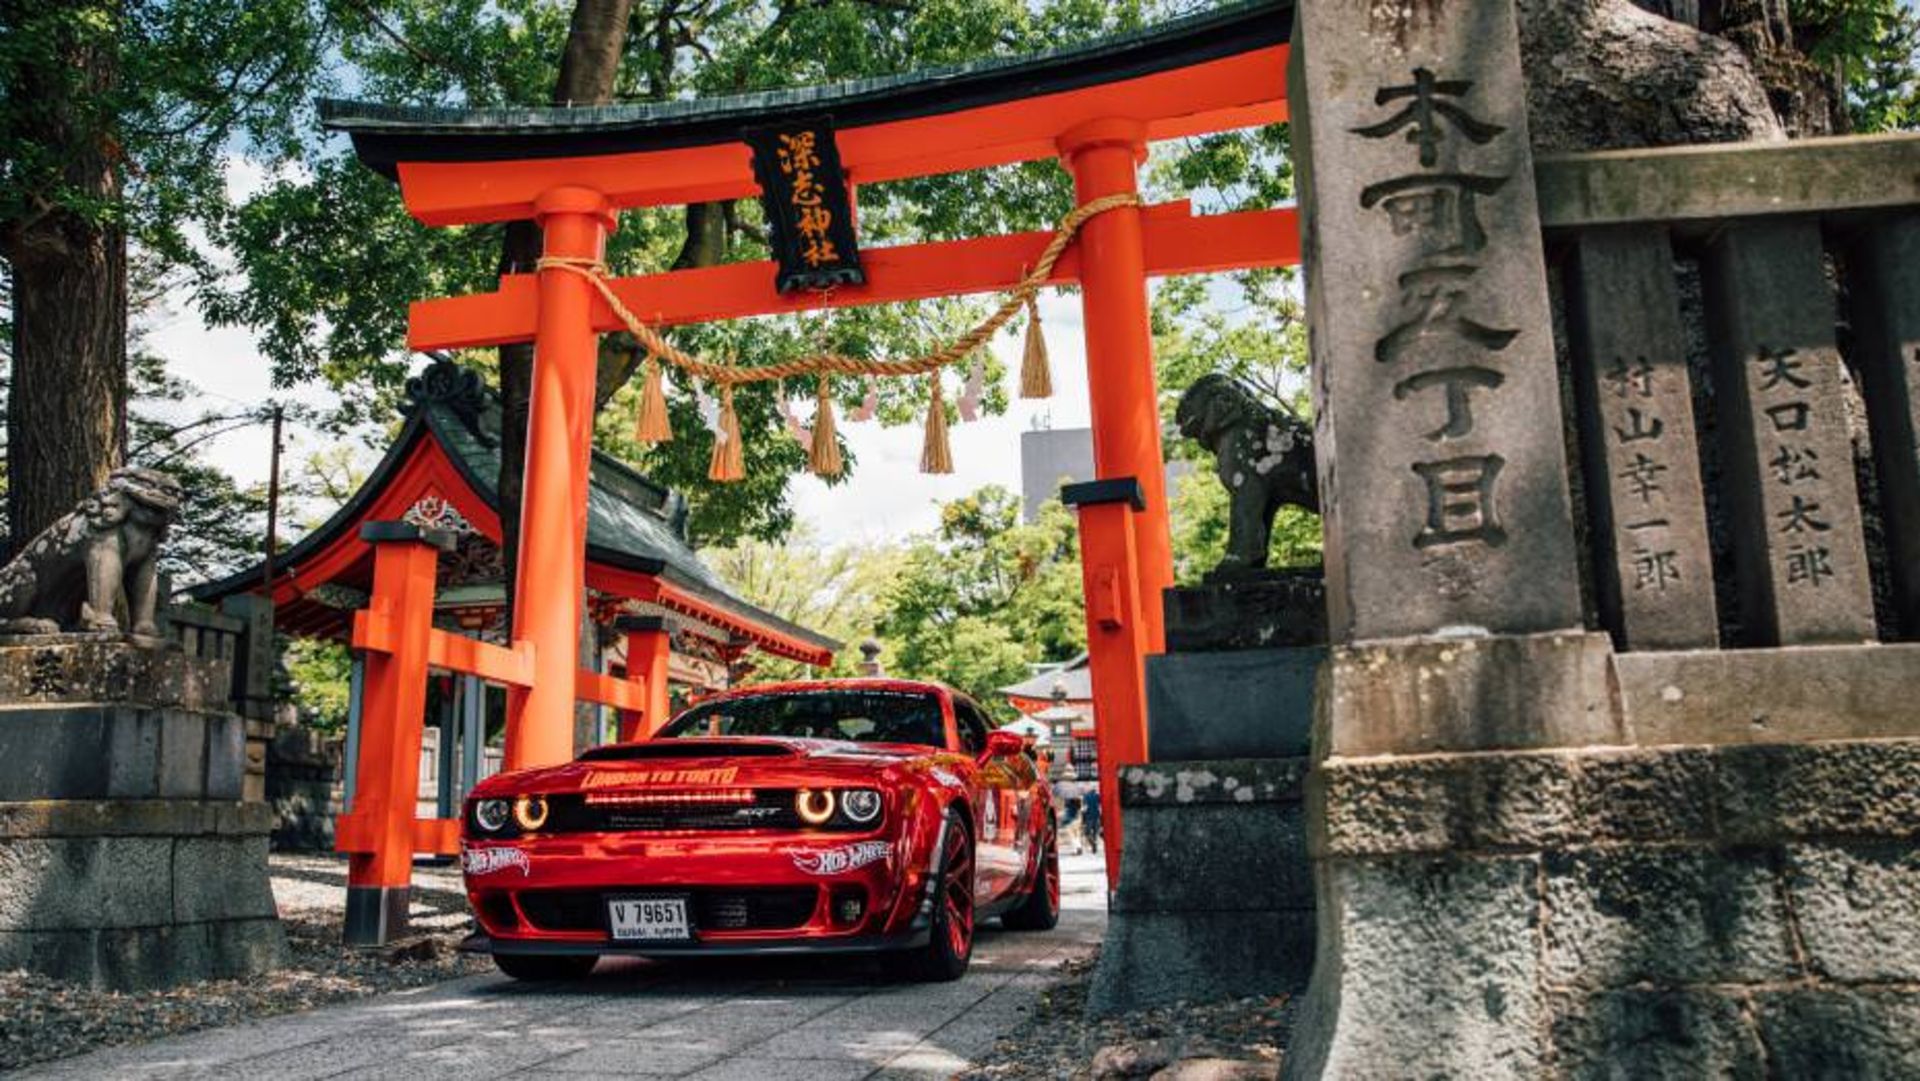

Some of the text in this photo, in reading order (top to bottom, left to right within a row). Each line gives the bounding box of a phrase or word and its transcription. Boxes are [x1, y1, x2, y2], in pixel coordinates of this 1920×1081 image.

[777, 131, 840, 267] 深志神社
[1605, 355, 1681, 592] 村山幸一郎
[1757, 345, 1834, 588] 矢口松太郎
[580, 767, 739, 789] LONDON TO TOKYO
[615, 902, 684, 924] V 79651
